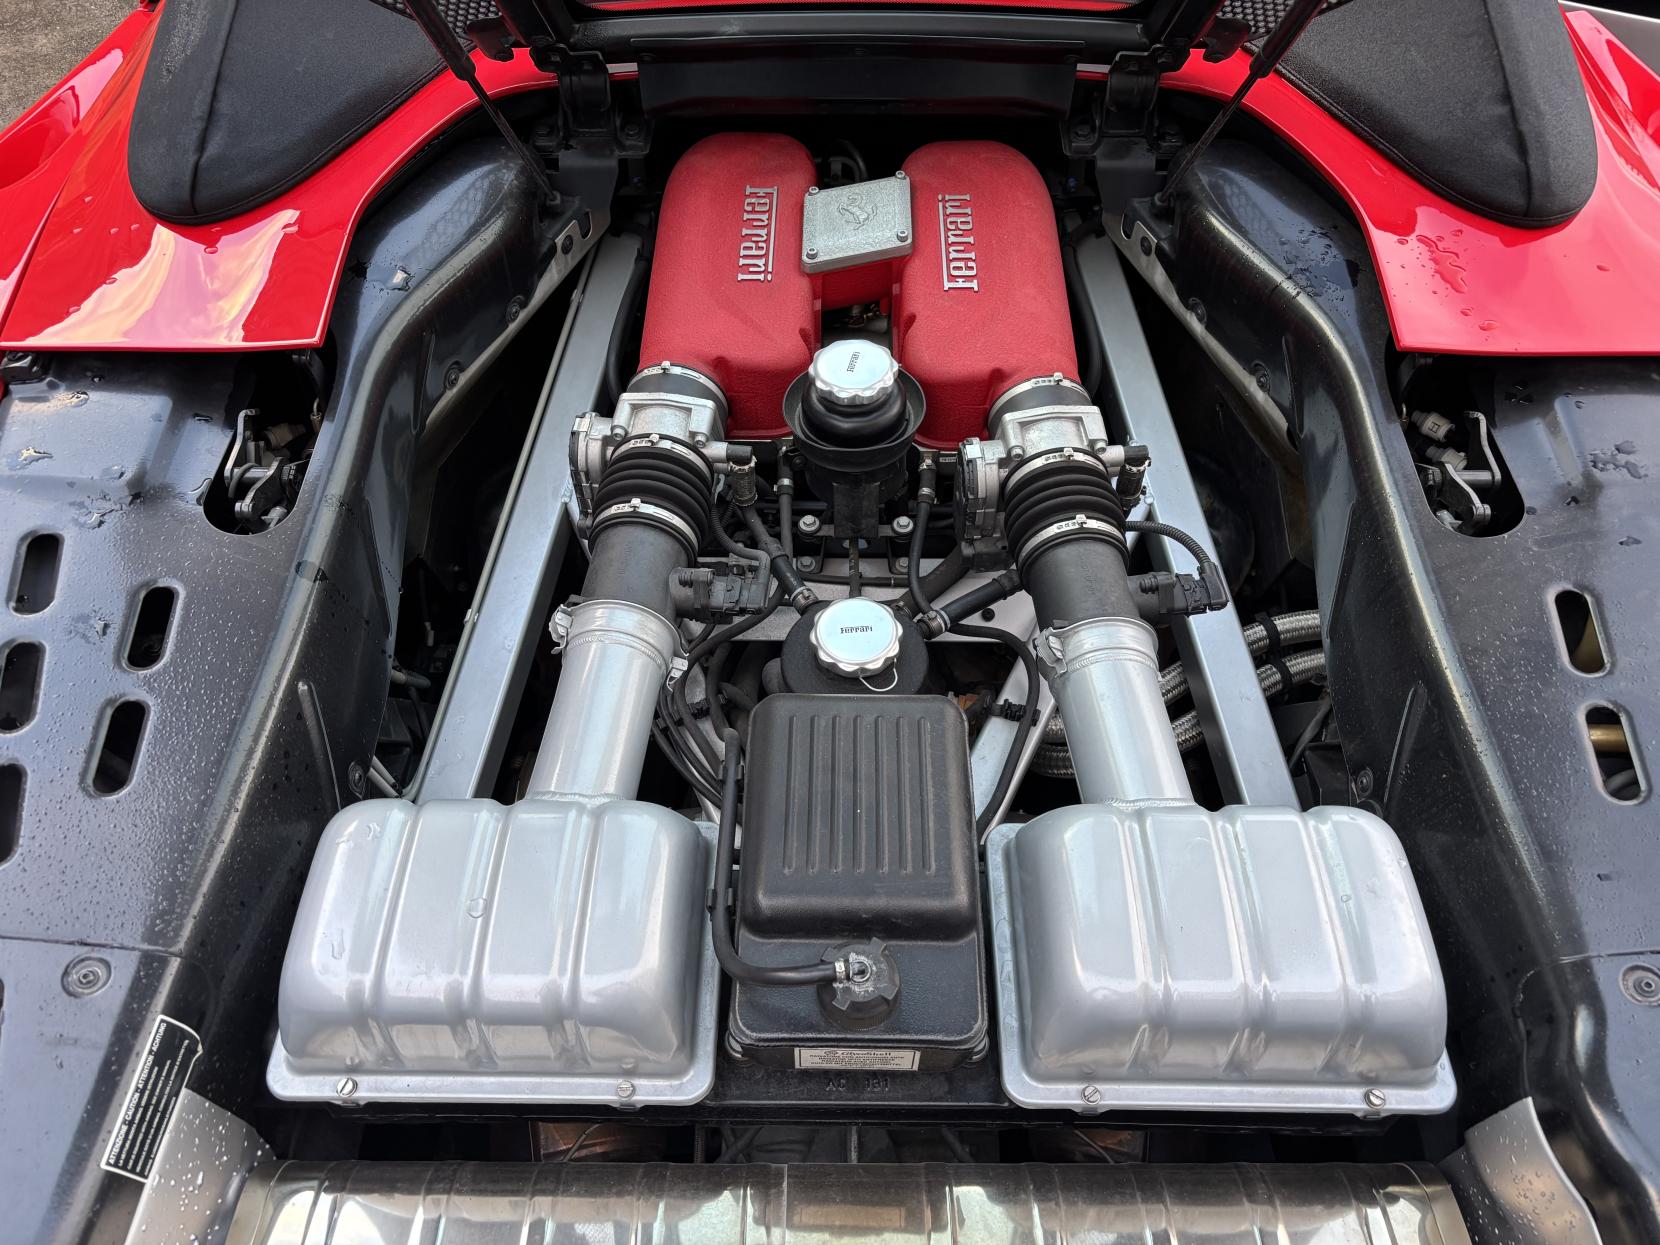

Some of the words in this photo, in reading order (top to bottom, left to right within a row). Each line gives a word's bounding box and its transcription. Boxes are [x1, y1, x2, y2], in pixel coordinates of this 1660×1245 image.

[737, 185, 778, 282] Ferrari
[938, 193, 979, 292] Ferrari
[846, 351, 861, 373] Ferrari
[840, 625, 873, 635] Ferrari
[109, 1124, 127, 1165] ATTENZIONE
[125, 1092, 141, 1121] CAUTION
[137, 1054, 155, 1090] ATTENTION
[151, 1022, 167, 1052] ACHTUNG
